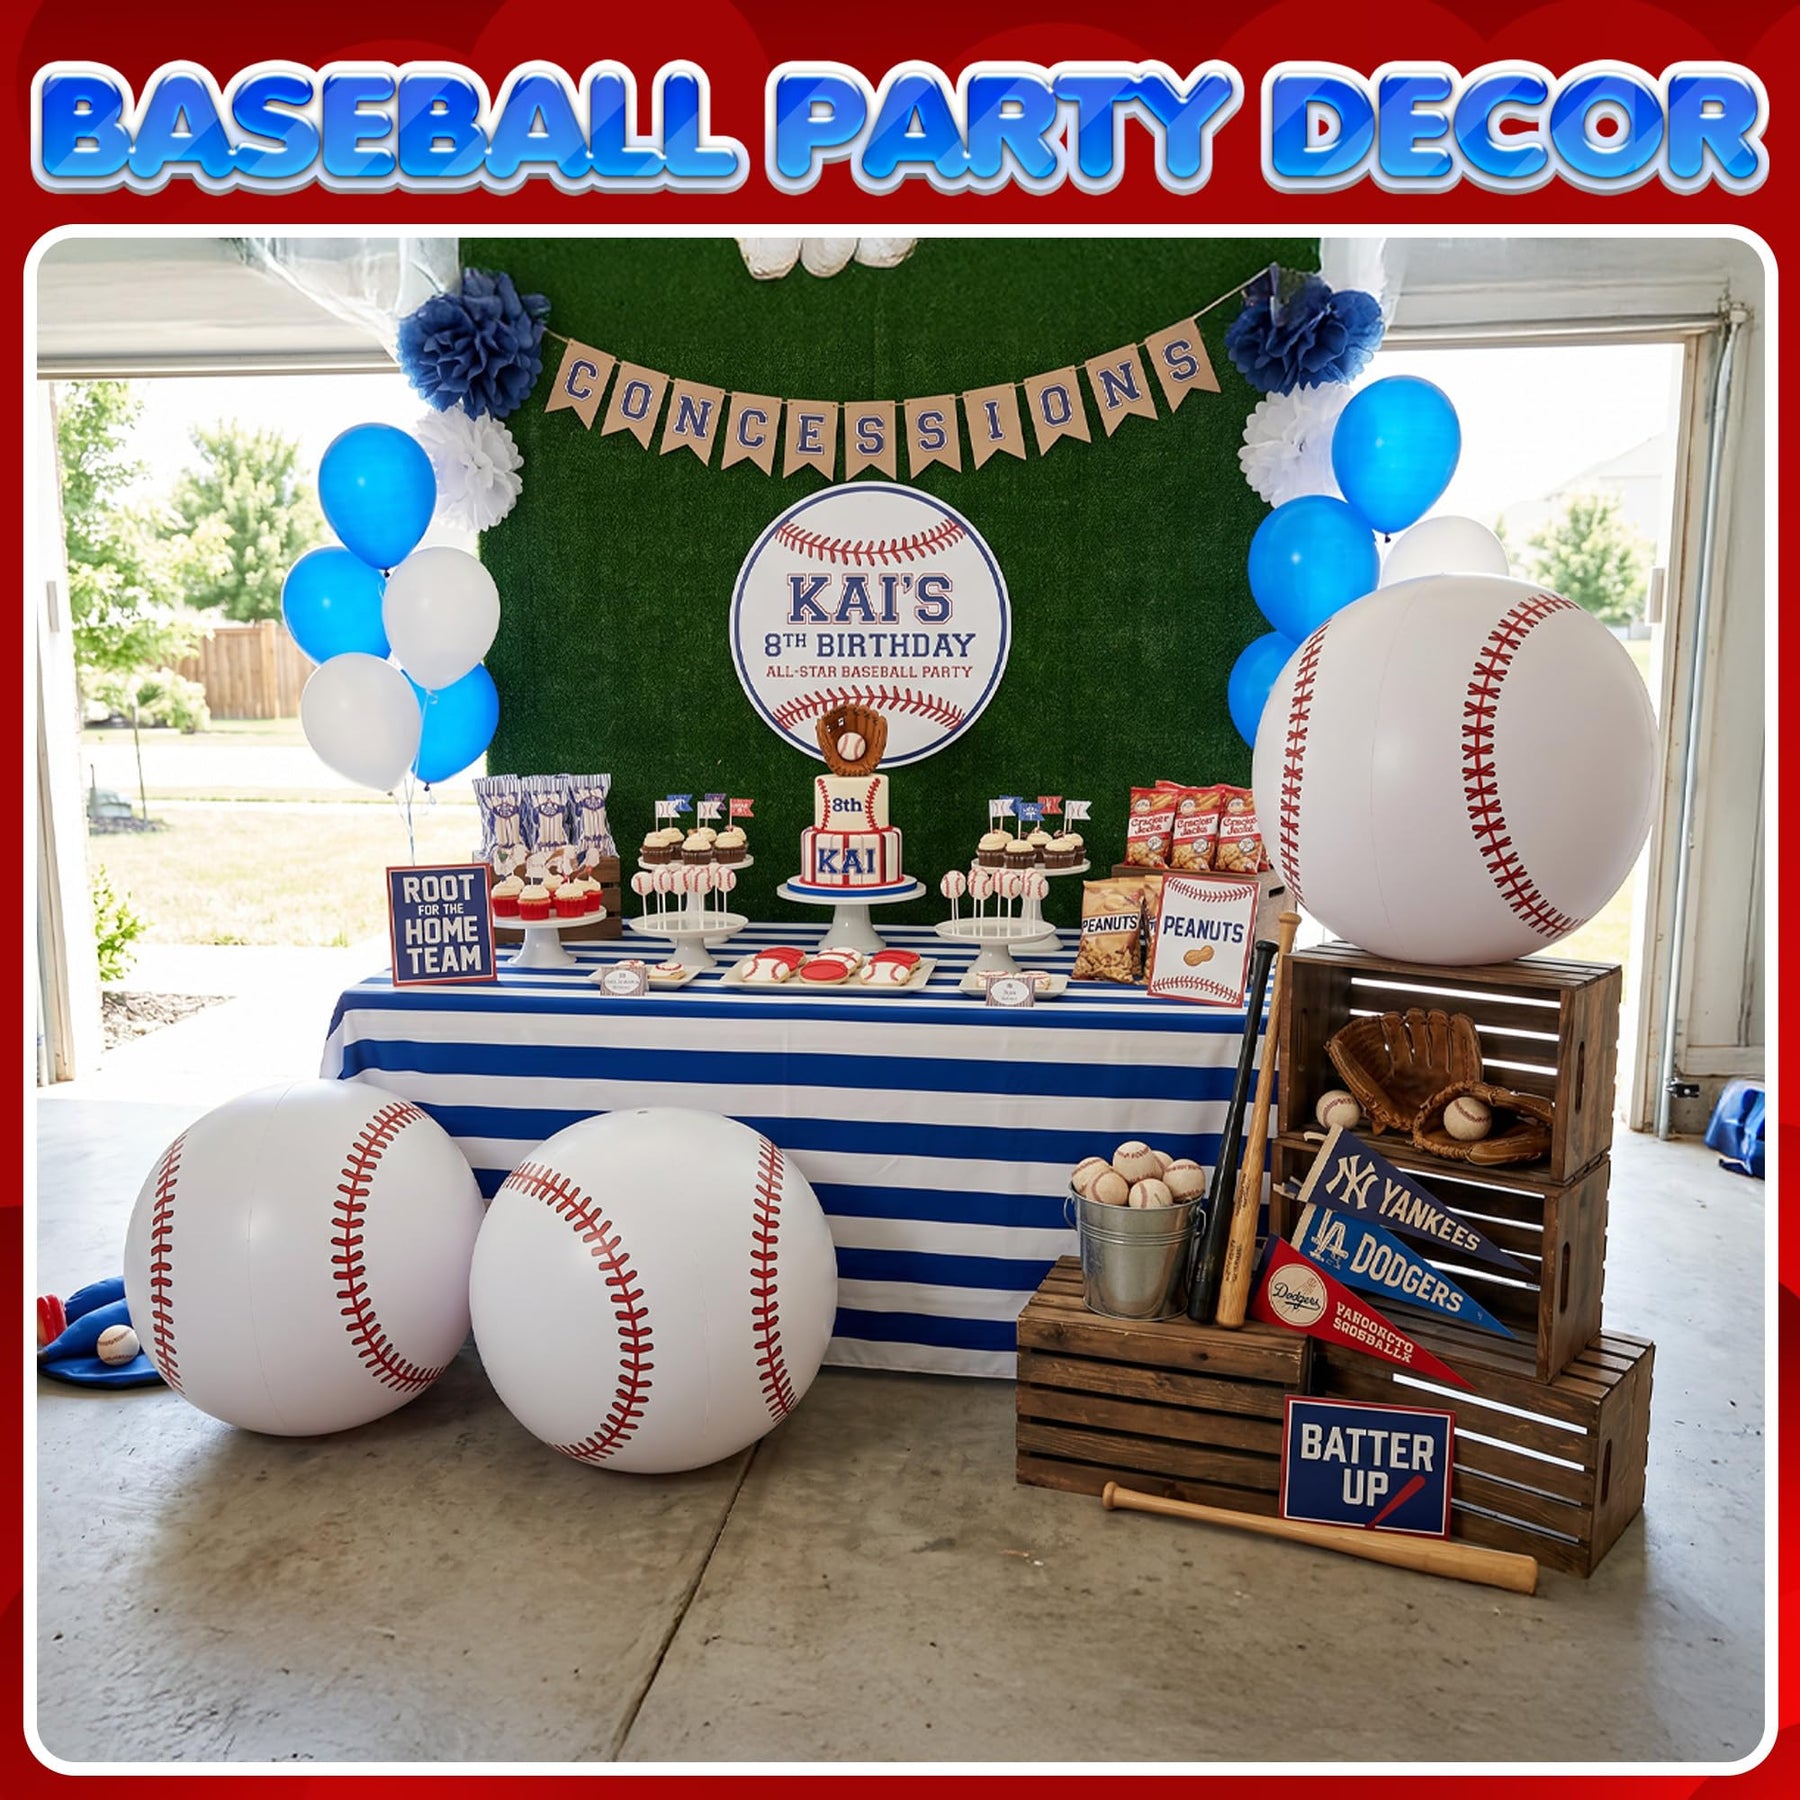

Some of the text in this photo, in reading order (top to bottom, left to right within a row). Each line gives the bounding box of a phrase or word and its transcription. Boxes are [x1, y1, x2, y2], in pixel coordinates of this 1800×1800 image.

[564, 336, 1201, 457] CONCESSIONS
[786, 572, 953, 625] KAI'S
[764, 633, 976, 658] 8TH BIRTHDAY
[766, 665, 973, 679] ALL-STAR BASEBALL PARTY
[831, 797, 863, 813] 8th
[817, 847, 877, 875] KAI
[402, 874, 475, 904] ROOT
[418, 903, 464, 916] FOR THE
[1082, 914, 1139, 934] PEANUTS
[405, 916, 479, 945] HOME
[1162, 914, 1245, 944] PEANUTS
[406, 945, 482, 975] TEAM
[1377, 1177, 1481, 1252] YANKEES
[1349, 1232, 1464, 1313] DODGERS
[1272, 1281, 1321, 1310] Dodgers
[1300, 1423, 1435, 1472] BATTER
[1342, 1468, 1389, 1507] UP
